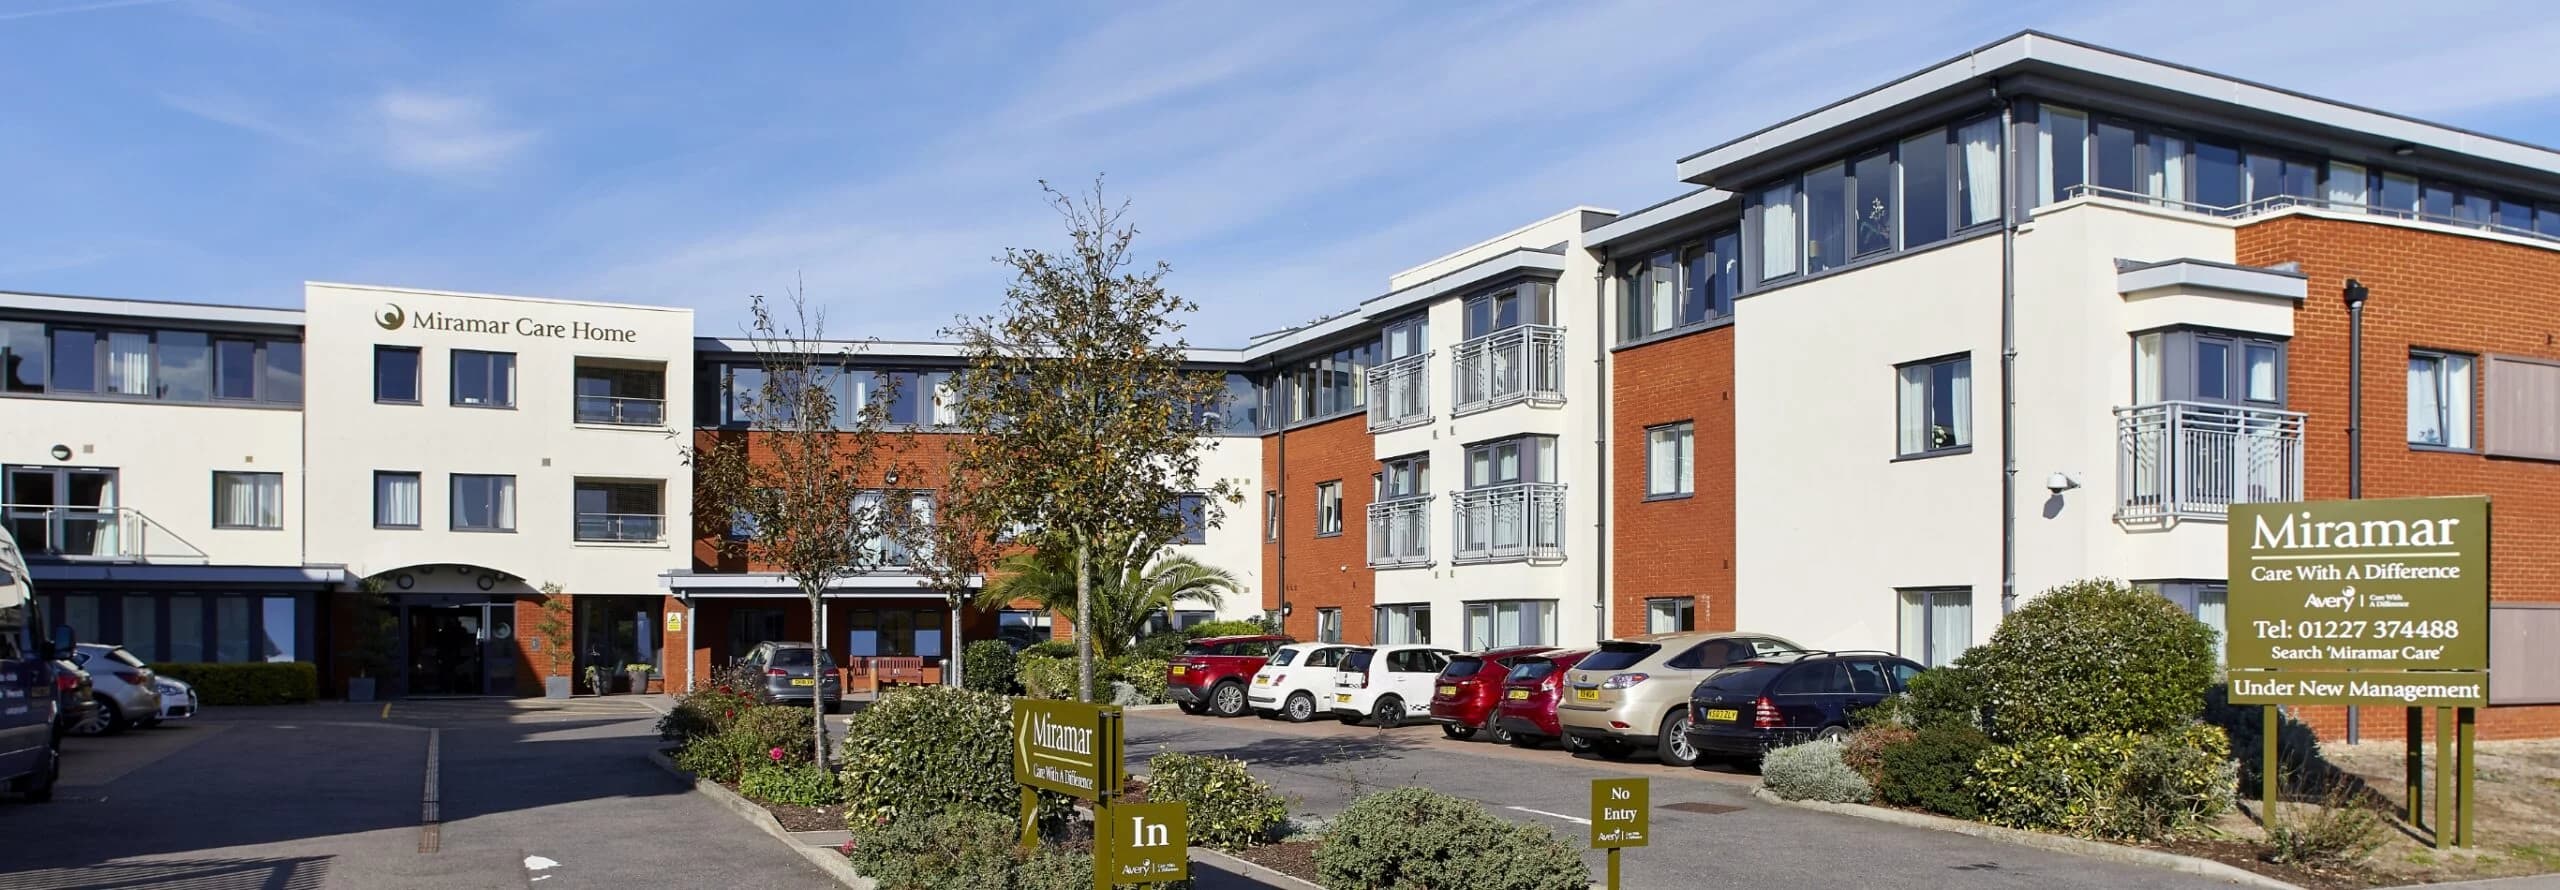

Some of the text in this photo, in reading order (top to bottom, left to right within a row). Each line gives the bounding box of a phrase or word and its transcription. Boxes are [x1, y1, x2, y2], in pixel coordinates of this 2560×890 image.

[413, 312, 637, 343] Miramar Care Home
[2251, 511, 2460, 550] Miramar
[2251, 562, 2460, 581] Care With A Difference
[2304, 592, 2355, 613] Avery
[2253, 620, 2459, 639] Tel: 01227 374488
[2271, 645, 2444, 660] Search 'Miramar Care'
[2233, 679, 2480, 702] Under New Management
[1033, 711, 1093, 755] Miramar
[1033, 763, 1046, 780] Care
[1045, 765, 1059, 782] With
[1064, 769, 1094, 790] Difference
[1611, 787, 1630, 800] No
[1604, 807, 1638, 823] Entry
[1132, 816, 1169, 848] In
[1121, 864, 1150, 877] Avery
